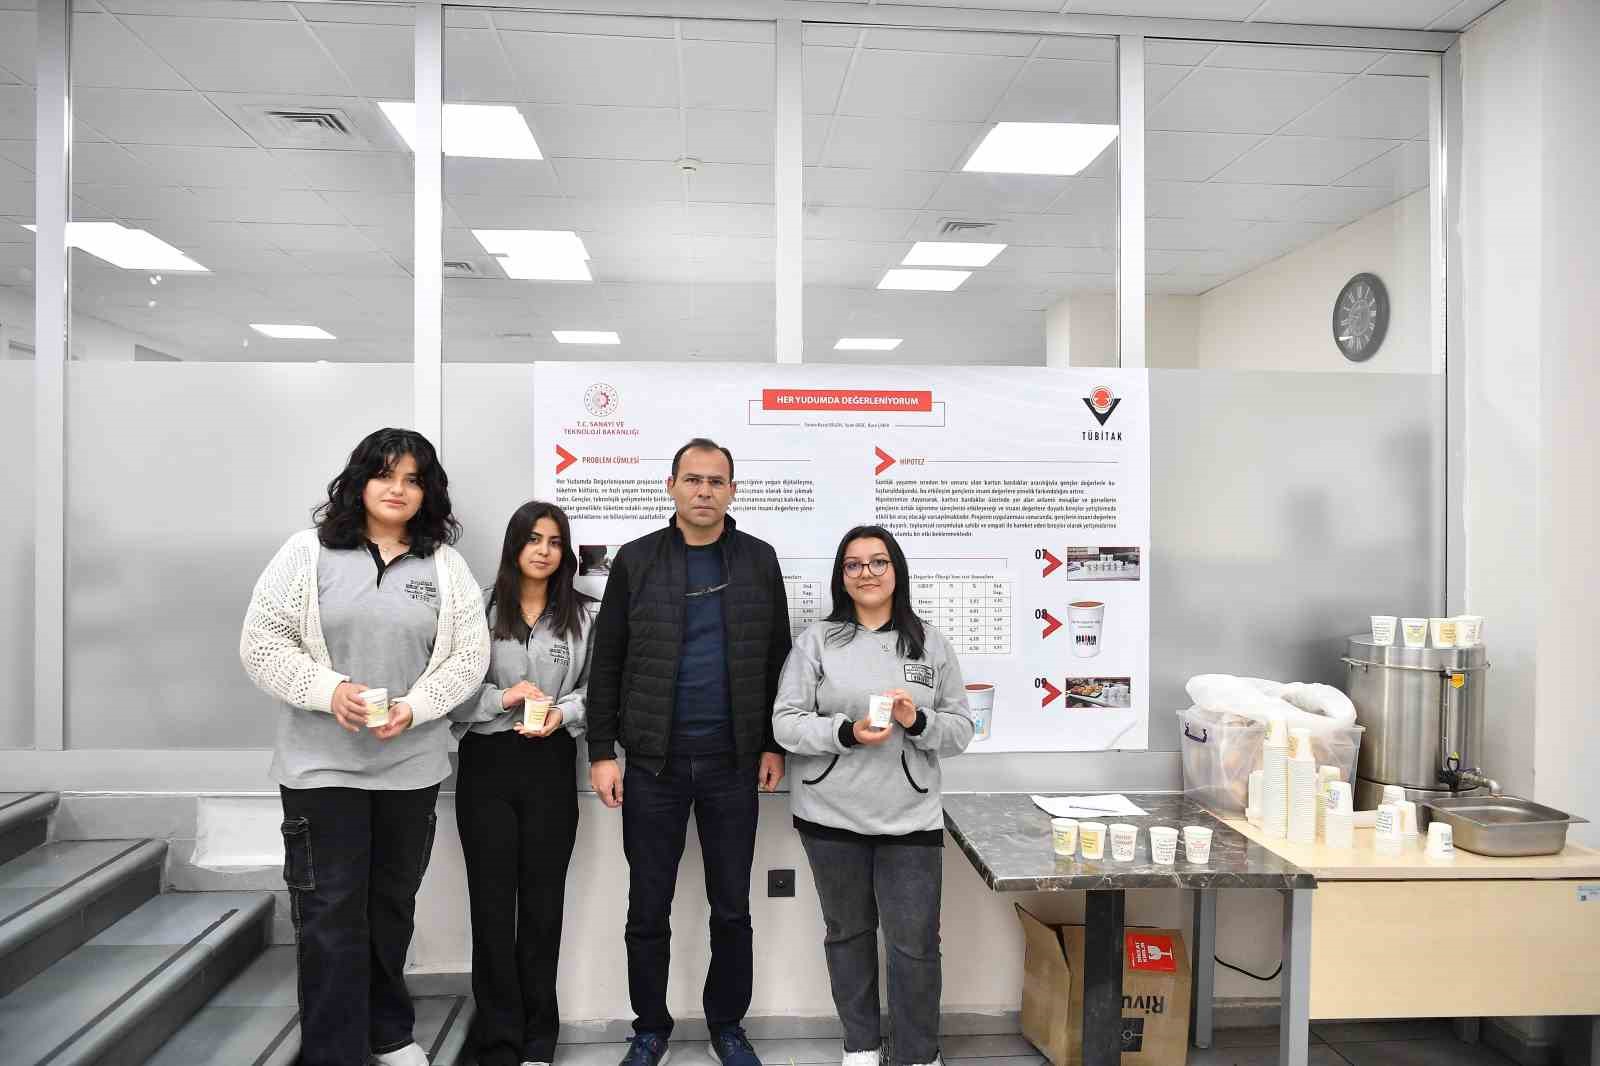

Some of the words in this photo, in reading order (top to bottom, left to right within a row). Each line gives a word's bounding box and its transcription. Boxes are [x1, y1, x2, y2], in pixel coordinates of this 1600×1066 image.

[777, 396, 794, 405] HER
[795, 396, 840, 405] YUDUMDA
[842, 396, 920, 405] DEĞERLENİYORUM
[616, 420, 625, 428] VE
[1082, 429, 1122, 441] TÜBİTAK
[582, 456, 612, 464] PROBLEM
[613, 456, 640, 464] CÜMLESİ
[900, 458, 925, 466] HİPOTEZ
